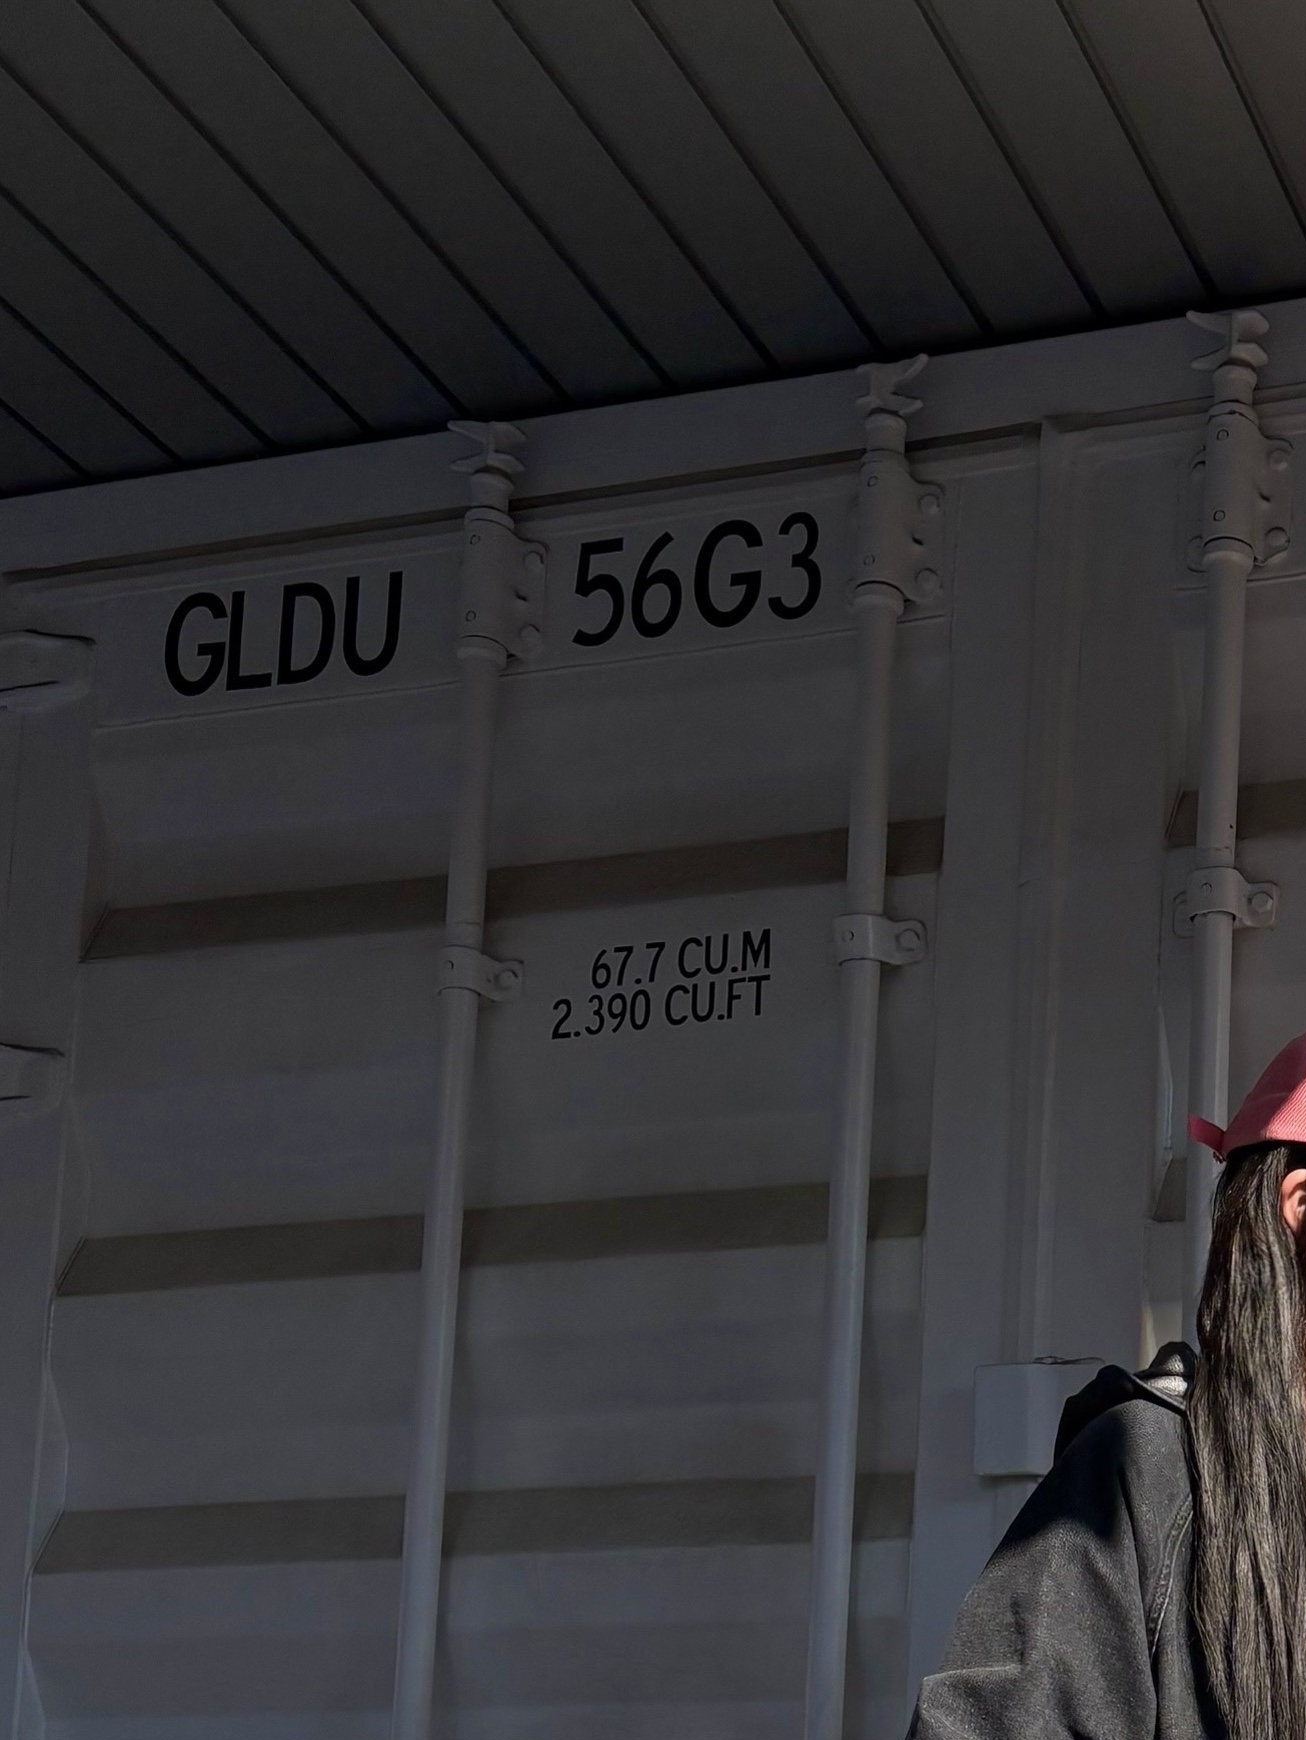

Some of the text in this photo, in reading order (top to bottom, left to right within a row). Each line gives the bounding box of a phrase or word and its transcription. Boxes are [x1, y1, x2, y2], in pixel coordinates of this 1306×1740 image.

[572, 512, 821, 646] 56G3
[164, 571, 403, 696] GLDU
[591, 928, 771, 990] 67.7 CU.M
[551, 974, 771, 1040] 2.390 CU.FT
